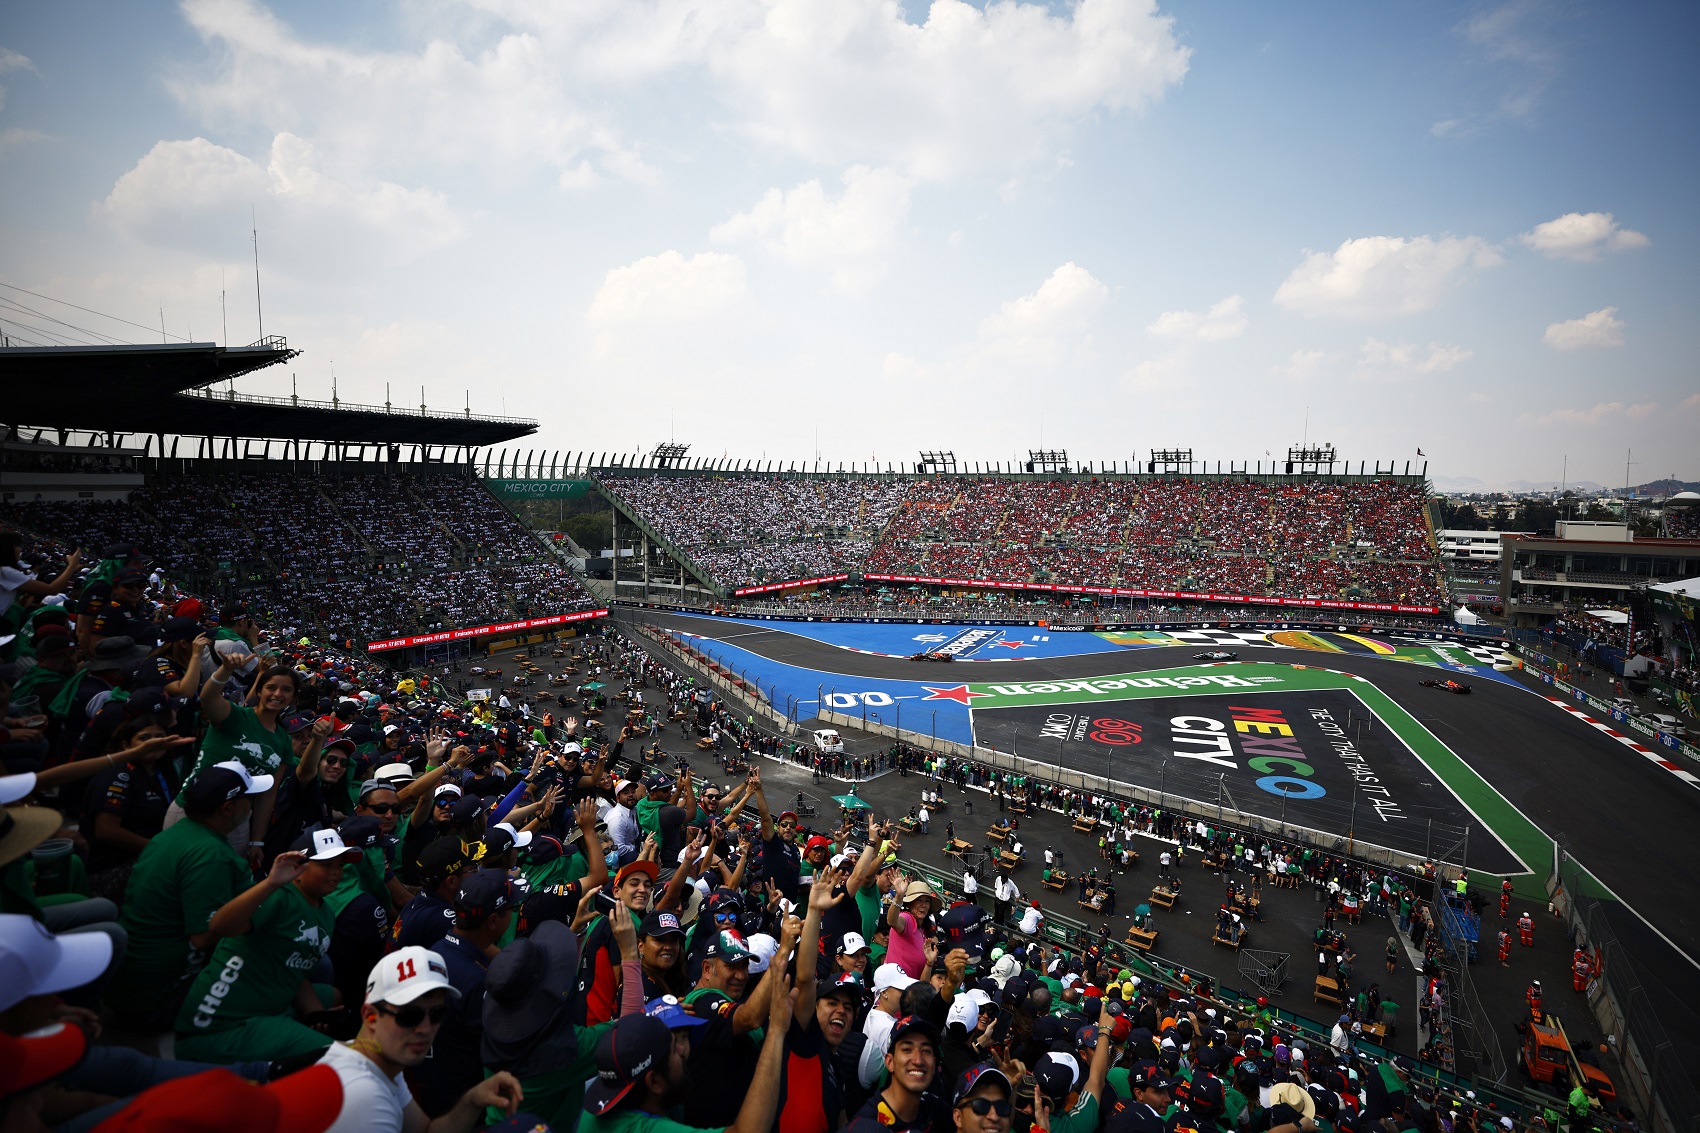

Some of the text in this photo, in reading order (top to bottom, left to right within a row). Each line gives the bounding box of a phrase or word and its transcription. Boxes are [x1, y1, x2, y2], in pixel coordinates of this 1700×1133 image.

[504, 483, 573, 492] MEXICO CITY
[987, 675, 1260, 695] Heineken
[1588, 697, 1608, 713] Heineken
[1039, 713, 1071, 739] CDMX
[1630, 719, 1653, 738] Heineken
[1170, 715, 1238, 769] CITY
[1228, 706, 1326, 799] MEXICO
[1308, 708, 1407, 821] THE CITY THAT HAS IT ALL
[322, 837, 334, 845] 11
[445, 860, 462, 874] 1ST
[949, 927, 959, 937] 11
[397, 958, 417, 983] 11
[631, 1054, 652, 1077] telcel
[964, 1068, 980, 1082] 11
